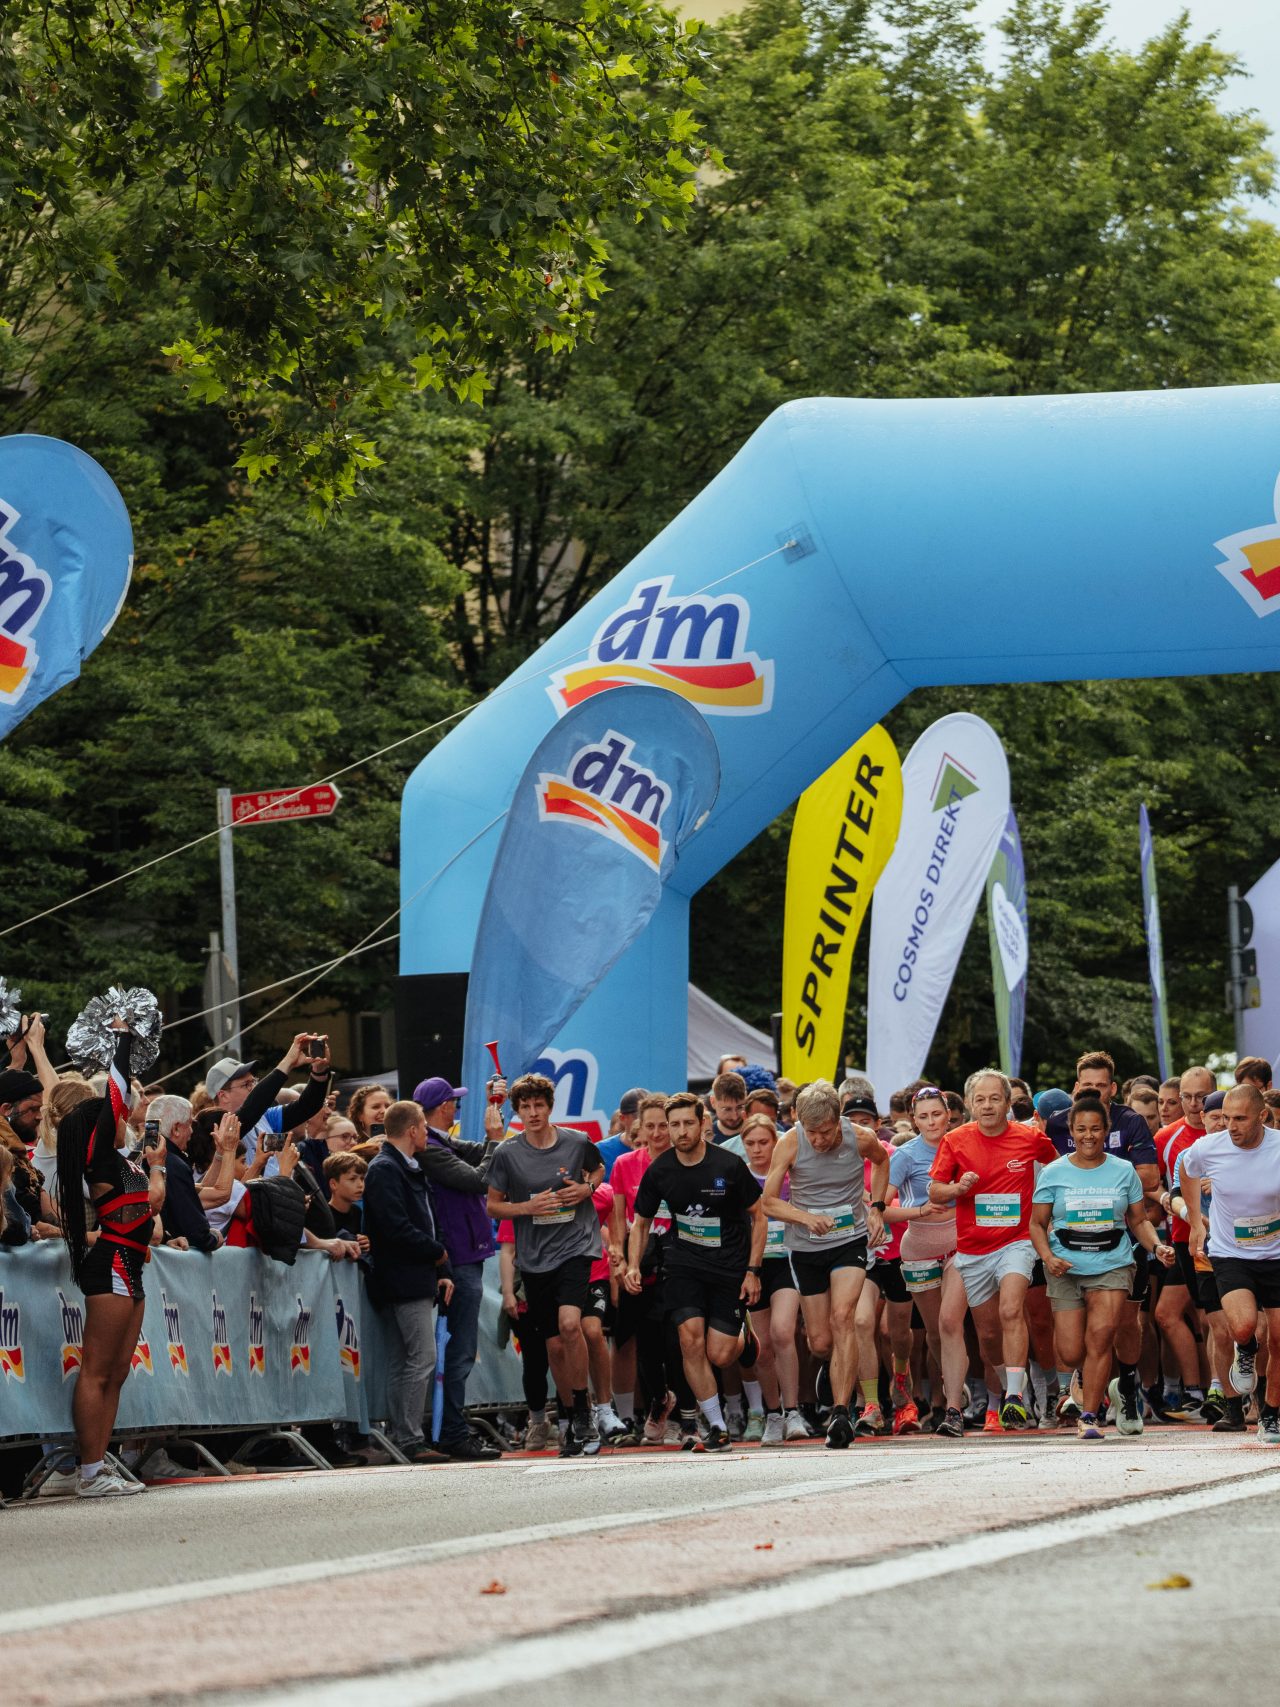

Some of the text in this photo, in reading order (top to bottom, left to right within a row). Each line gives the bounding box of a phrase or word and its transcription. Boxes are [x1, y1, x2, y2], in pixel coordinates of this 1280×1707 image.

[0, 490, 46, 635] m
[597, 584, 740, 663] dm
[571, 737, 665, 826] dm
[795, 753, 885, 1058] SPRINTER
[893, 784, 965, 1002] COSMOS DIREKT
[689, 1225, 705, 1233] Marc
[1064, 1186, 1121, 1197] saarbasar
